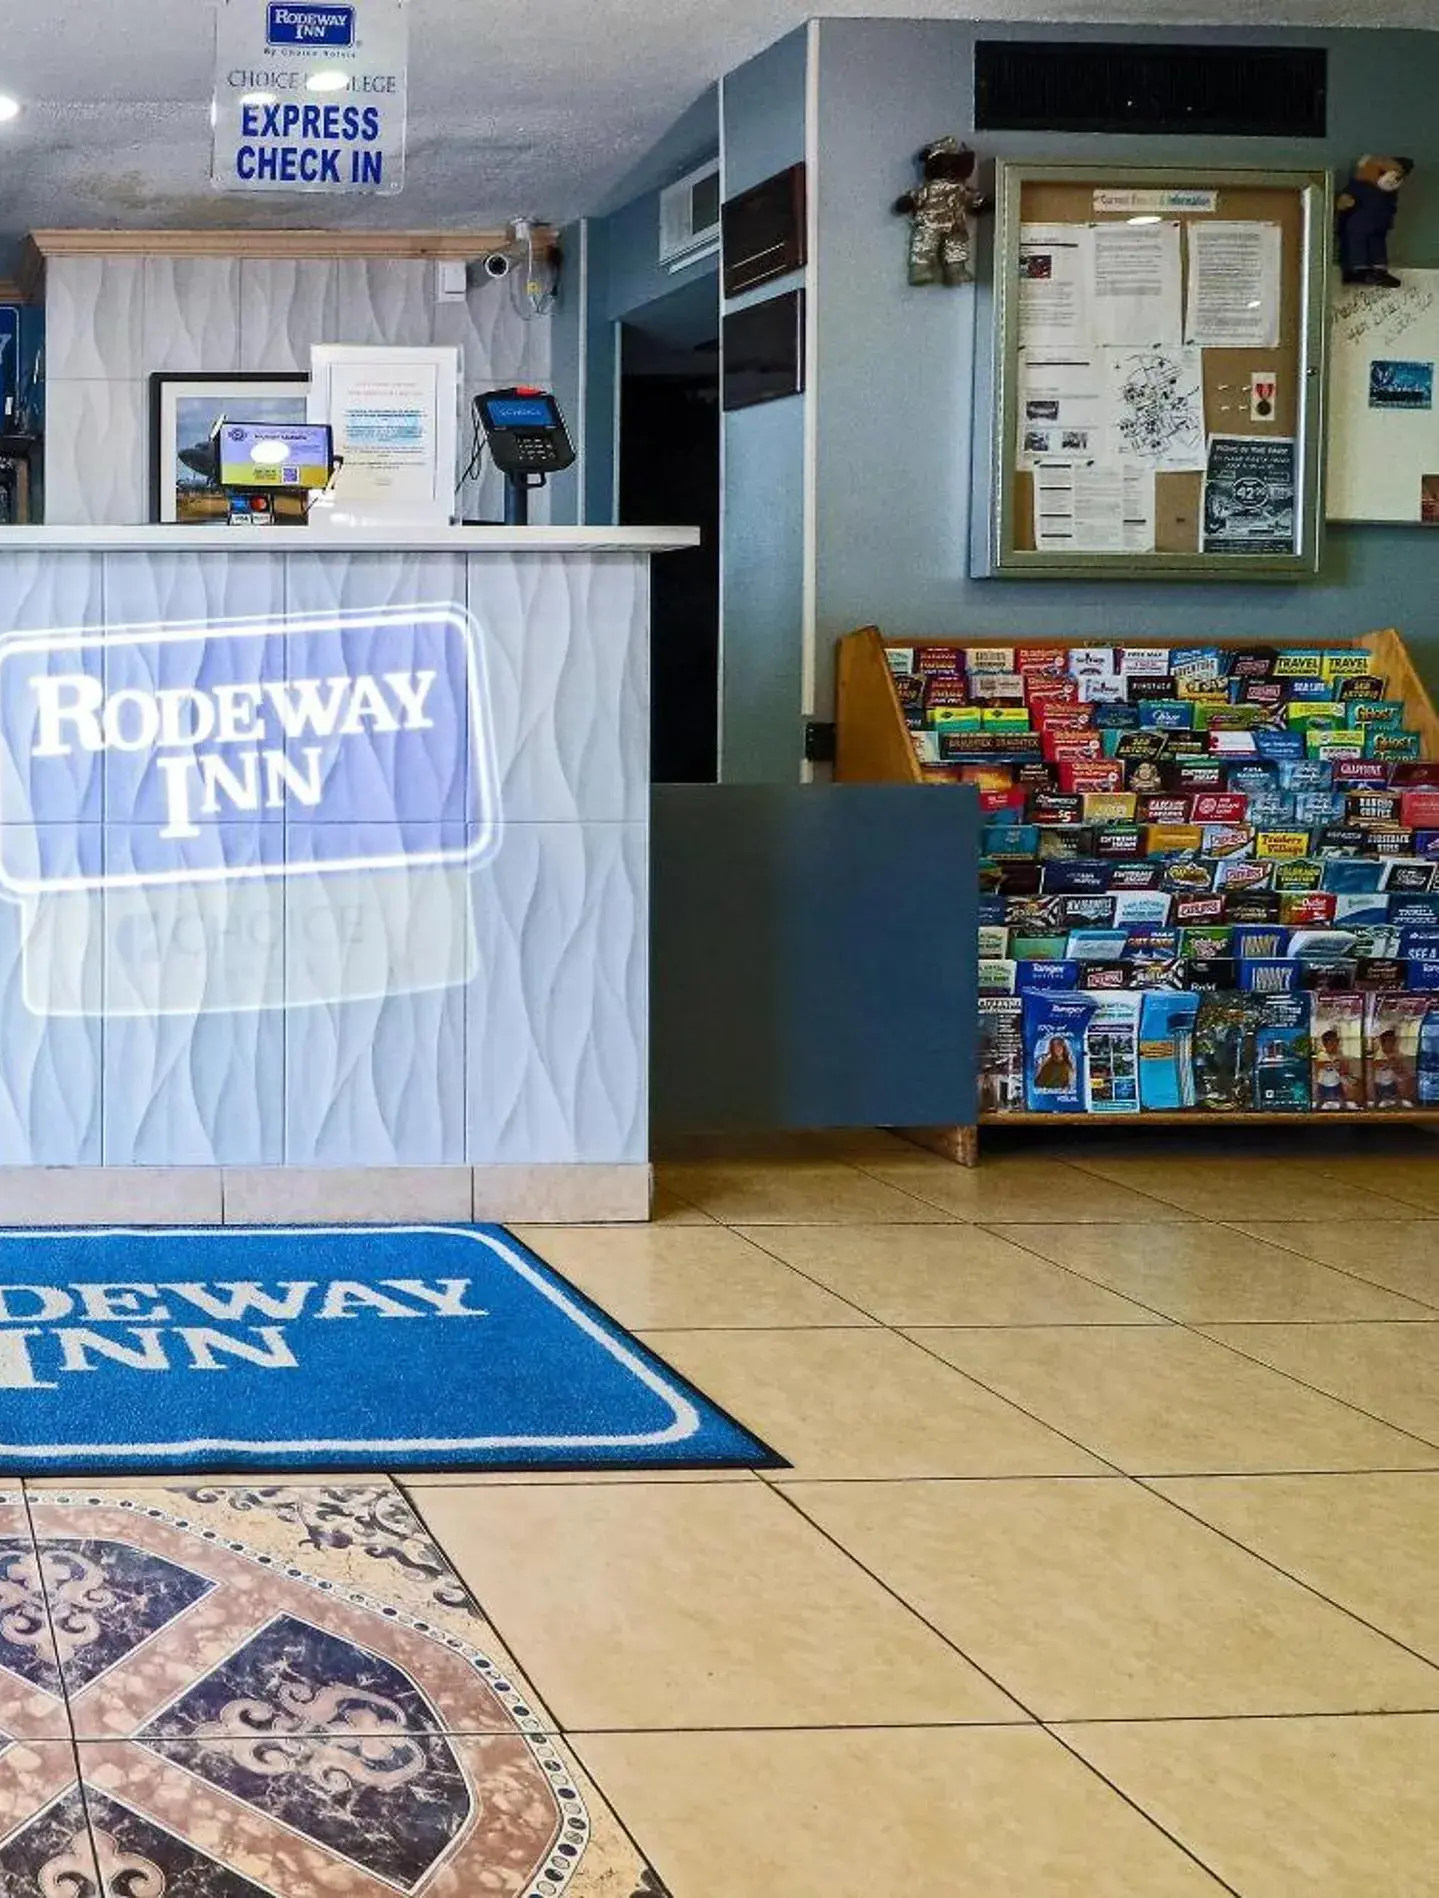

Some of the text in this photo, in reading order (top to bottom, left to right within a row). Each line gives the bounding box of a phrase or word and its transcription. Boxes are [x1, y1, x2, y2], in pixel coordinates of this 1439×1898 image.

[275, 9, 347, 26] RODEWAY
[295, 25, 326, 40] INN
[227, 70, 300, 90] CHOICE
[242, 103, 379, 141] EXPRESS
[236, 145, 382, 184] CHECK IN
[1279, 658, 1318, 668] TRAVEL
[1329, 658, 1368, 668] TRAVEL
[28, 670, 437, 757] RODEWAY
[157, 747, 323, 838] INN
